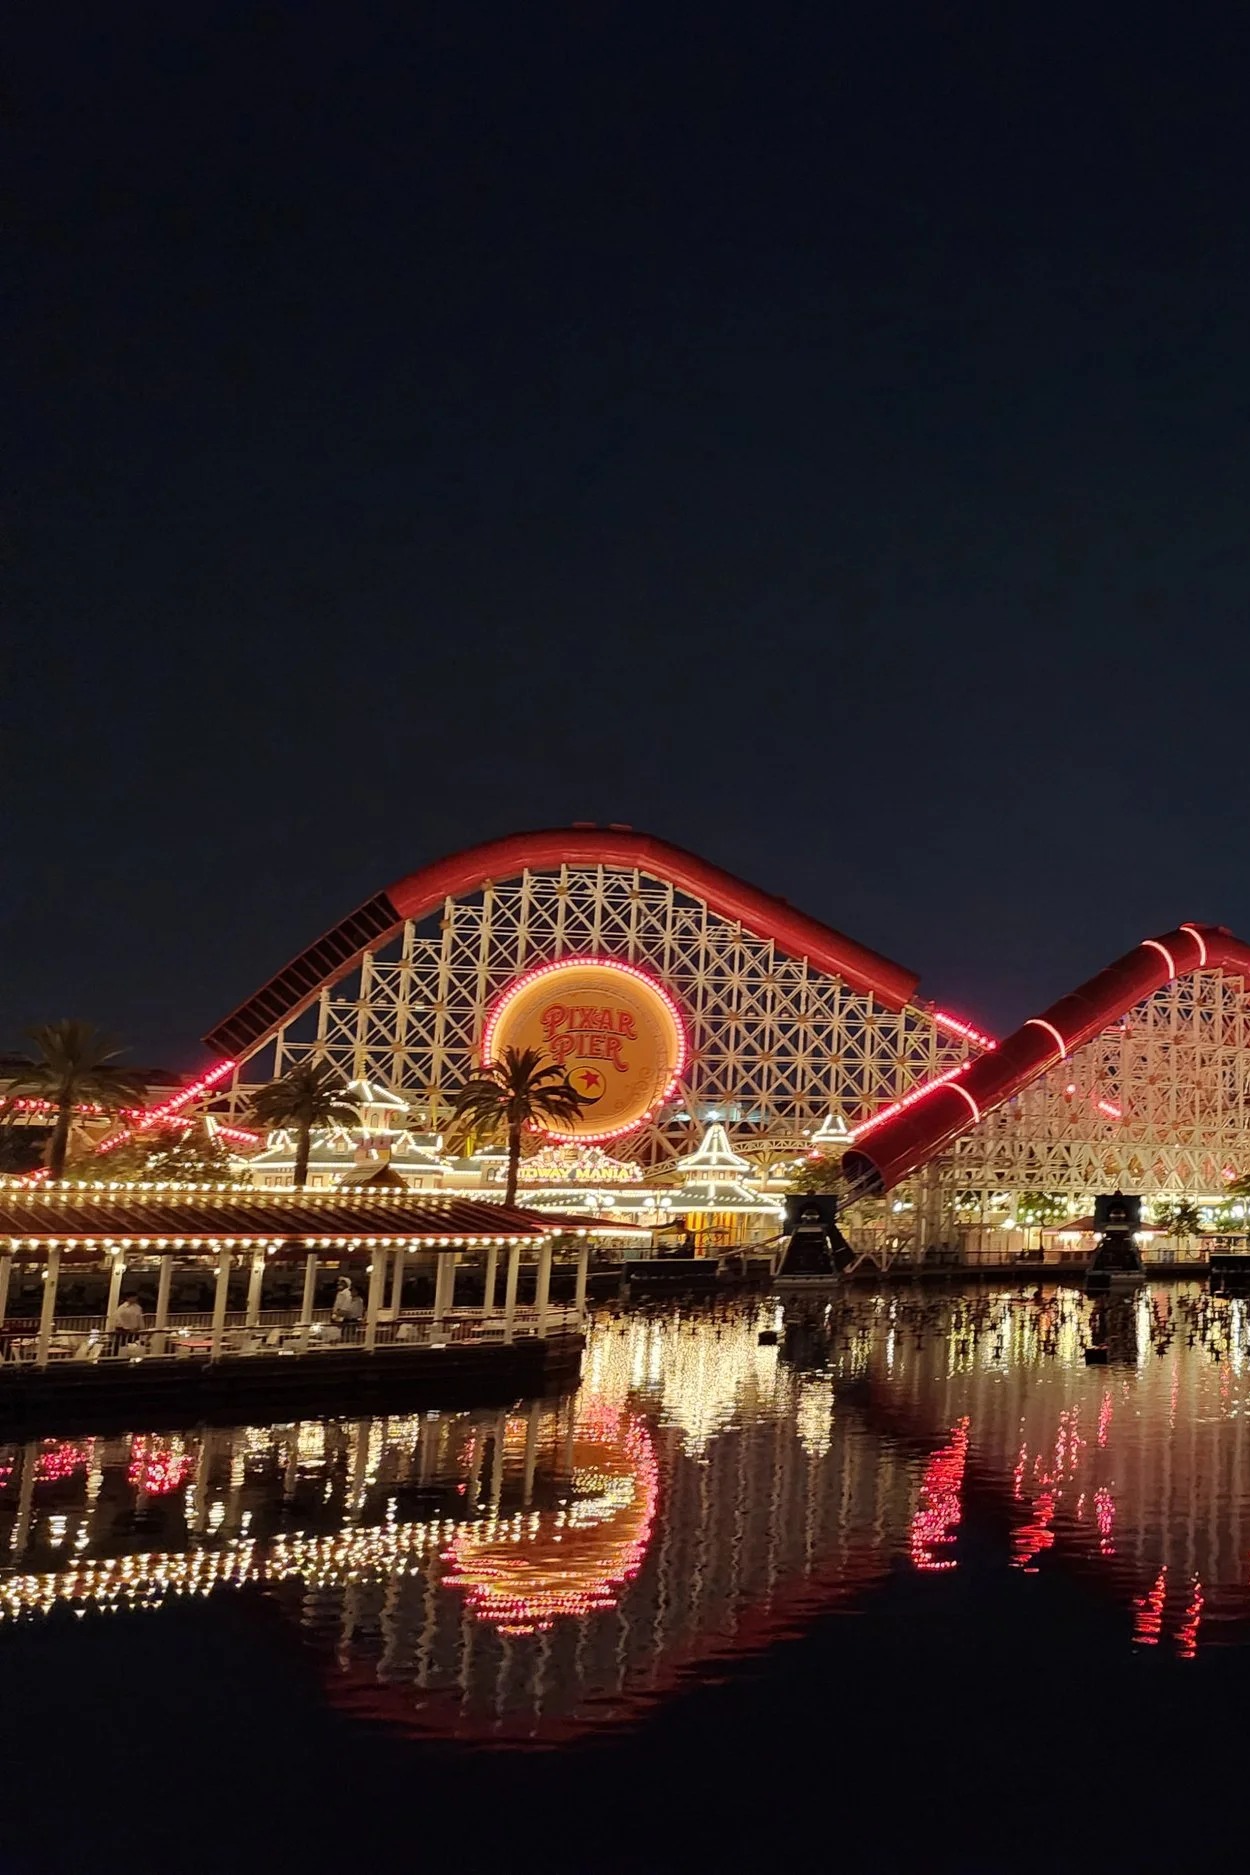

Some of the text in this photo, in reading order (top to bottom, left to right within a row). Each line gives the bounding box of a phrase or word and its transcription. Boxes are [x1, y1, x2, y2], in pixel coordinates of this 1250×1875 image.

[541, 1003, 637, 1041] PIXAR
[550, 1034, 629, 1072] PIER
[518, 1168, 569, 1179] IDWAY
